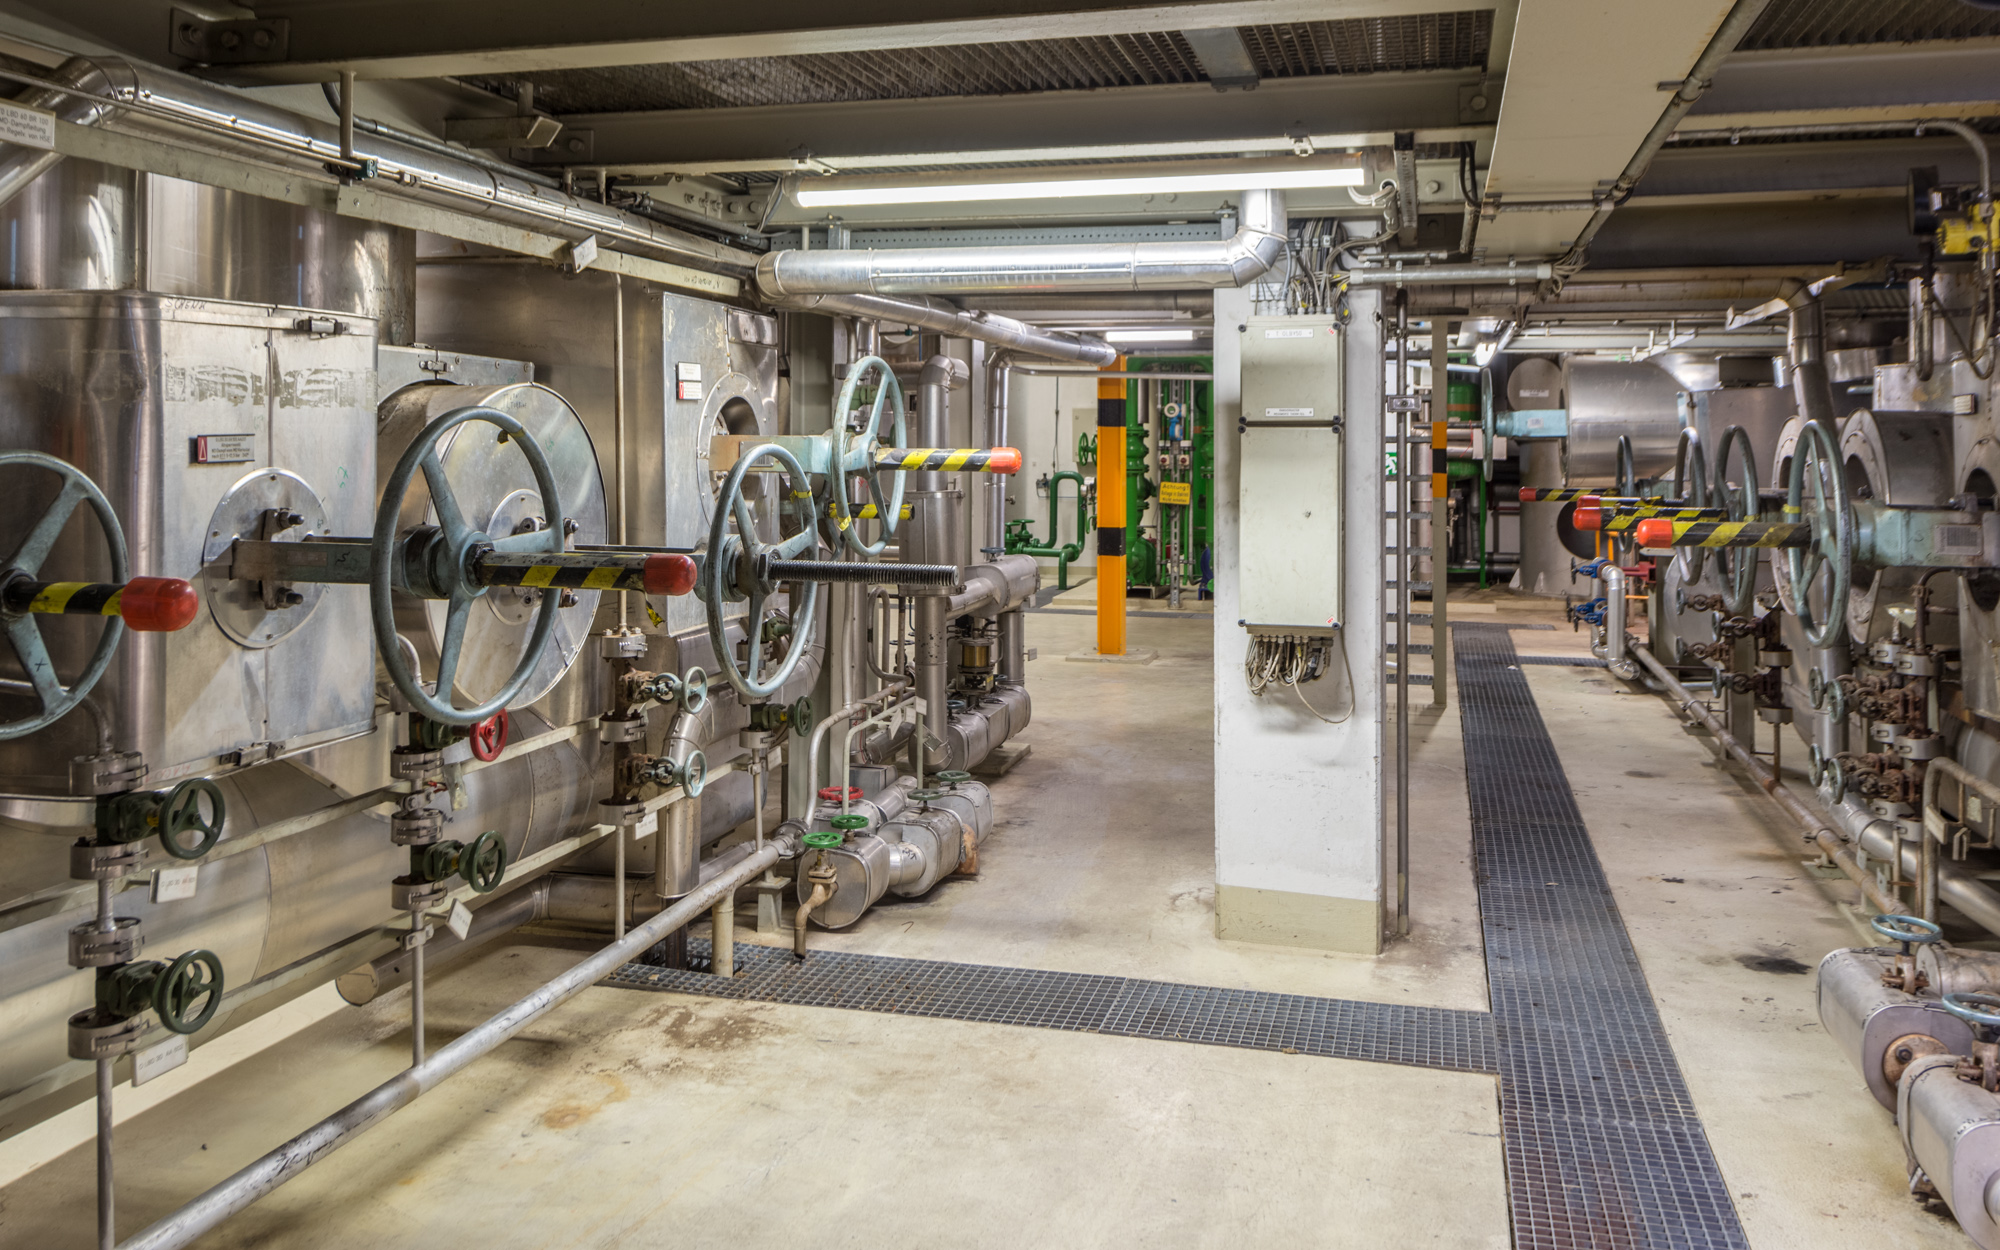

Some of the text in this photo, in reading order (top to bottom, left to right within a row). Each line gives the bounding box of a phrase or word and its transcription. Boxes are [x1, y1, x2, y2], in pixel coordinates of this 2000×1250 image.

[6, 109, 19, 118] LBD
[29, 114, 37, 122] BR
[39, 117, 49, 126] 100
